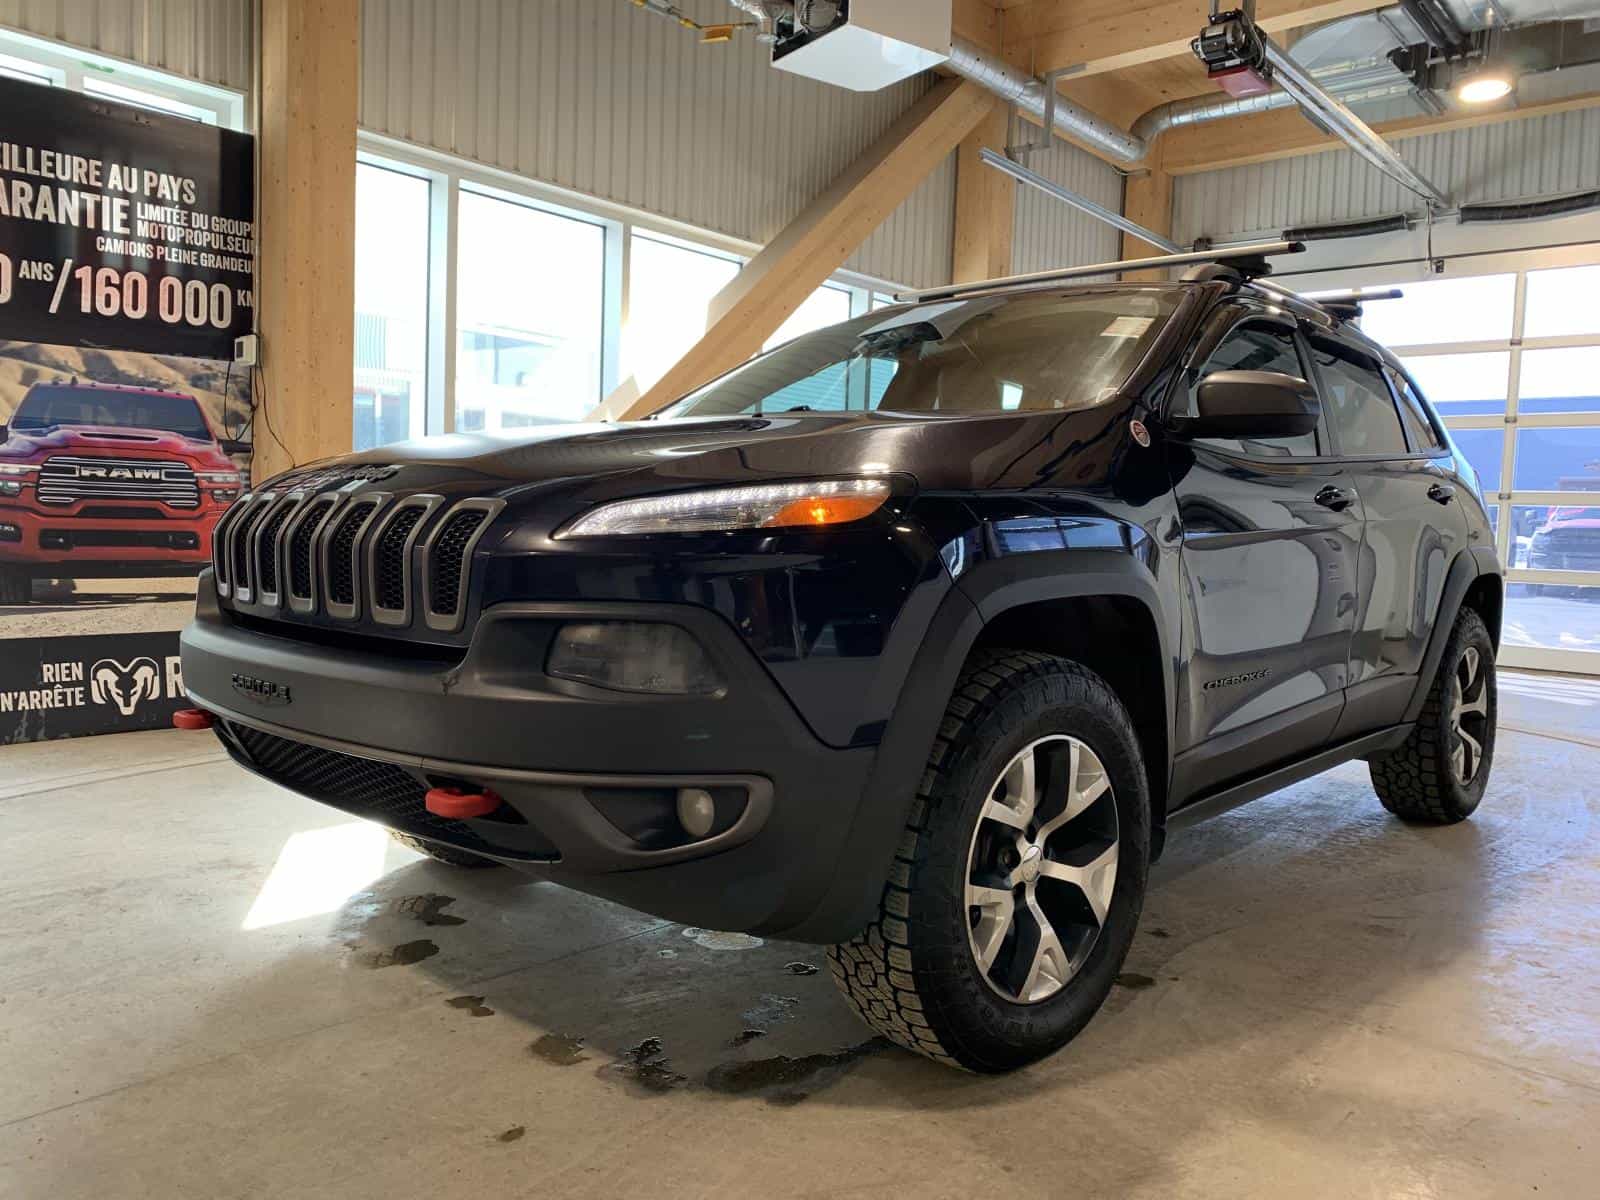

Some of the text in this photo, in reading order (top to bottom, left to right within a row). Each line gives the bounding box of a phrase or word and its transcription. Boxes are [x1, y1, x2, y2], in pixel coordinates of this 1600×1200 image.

[0, 142, 196, 204] ILLEURE AU PAYS
[136, 201, 254, 237] LIMITÉE DU GROUP
[96, 236, 254, 274] CAMIONS PLEINE GRANDEU
[136, 220, 254, 255] MOTOPROPULSEU
[18, 259, 55, 282] ANS
[159, 275, 232, 329] 000
[80, 466, 161, 480] RAM
[42, 662, 83, 683] RIEN
[0, 684, 86, 712] N'ARRÊTE
